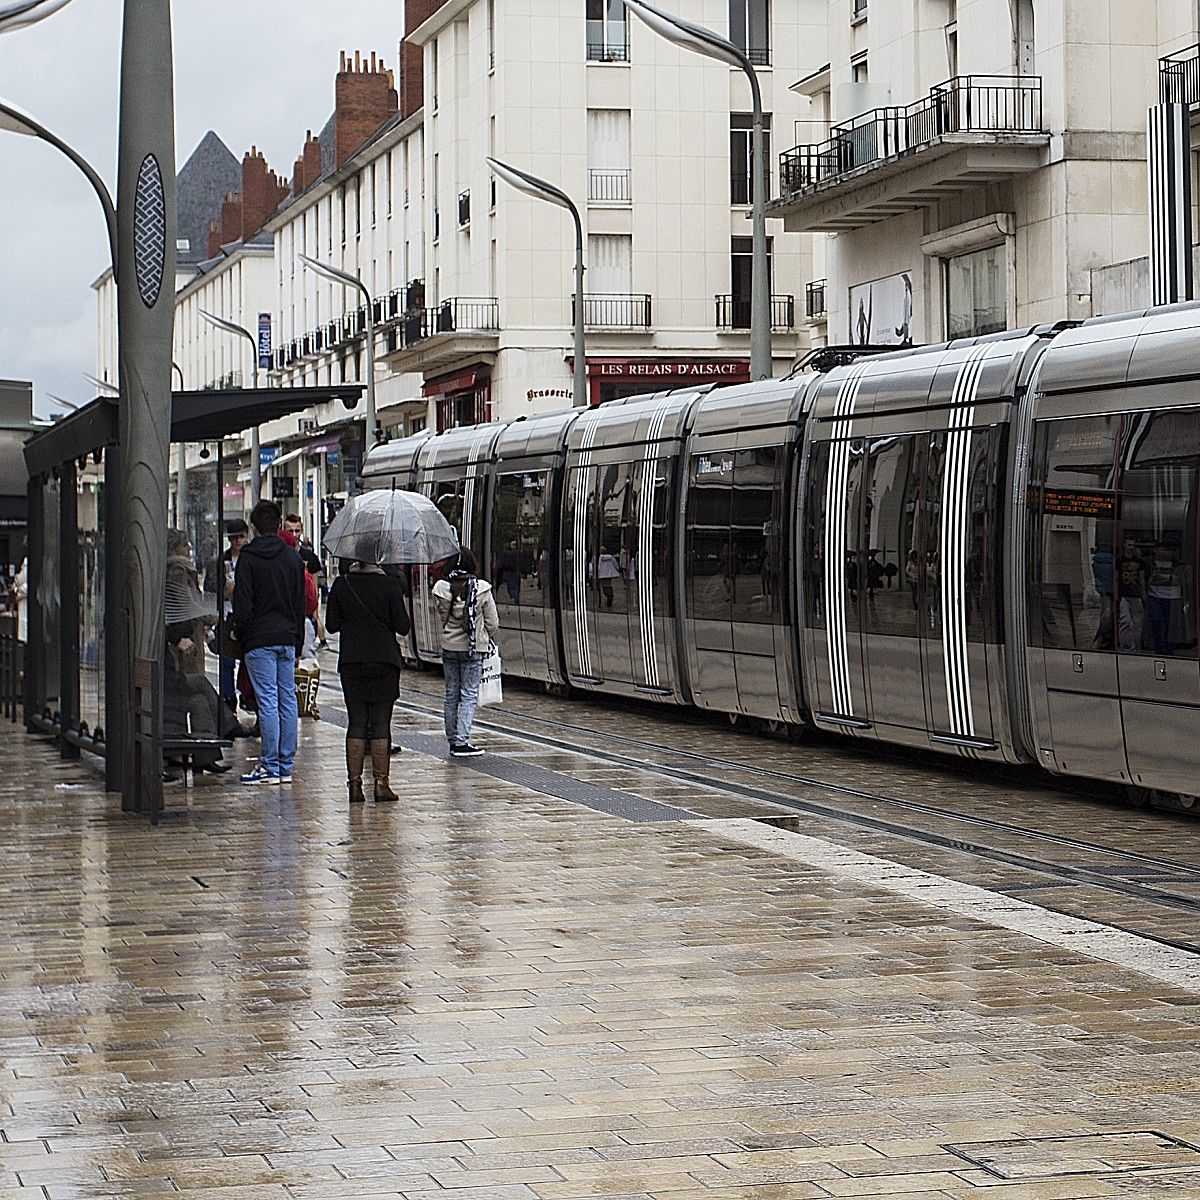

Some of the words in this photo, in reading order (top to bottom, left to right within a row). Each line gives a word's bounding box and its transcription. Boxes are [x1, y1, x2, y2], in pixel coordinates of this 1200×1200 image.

[601, 364, 623, 375] LES
[629, 364, 672, 375] RELAIS
[678, 364, 737, 374] D'ALSACE
[527, 389, 573, 401] Brasserie
